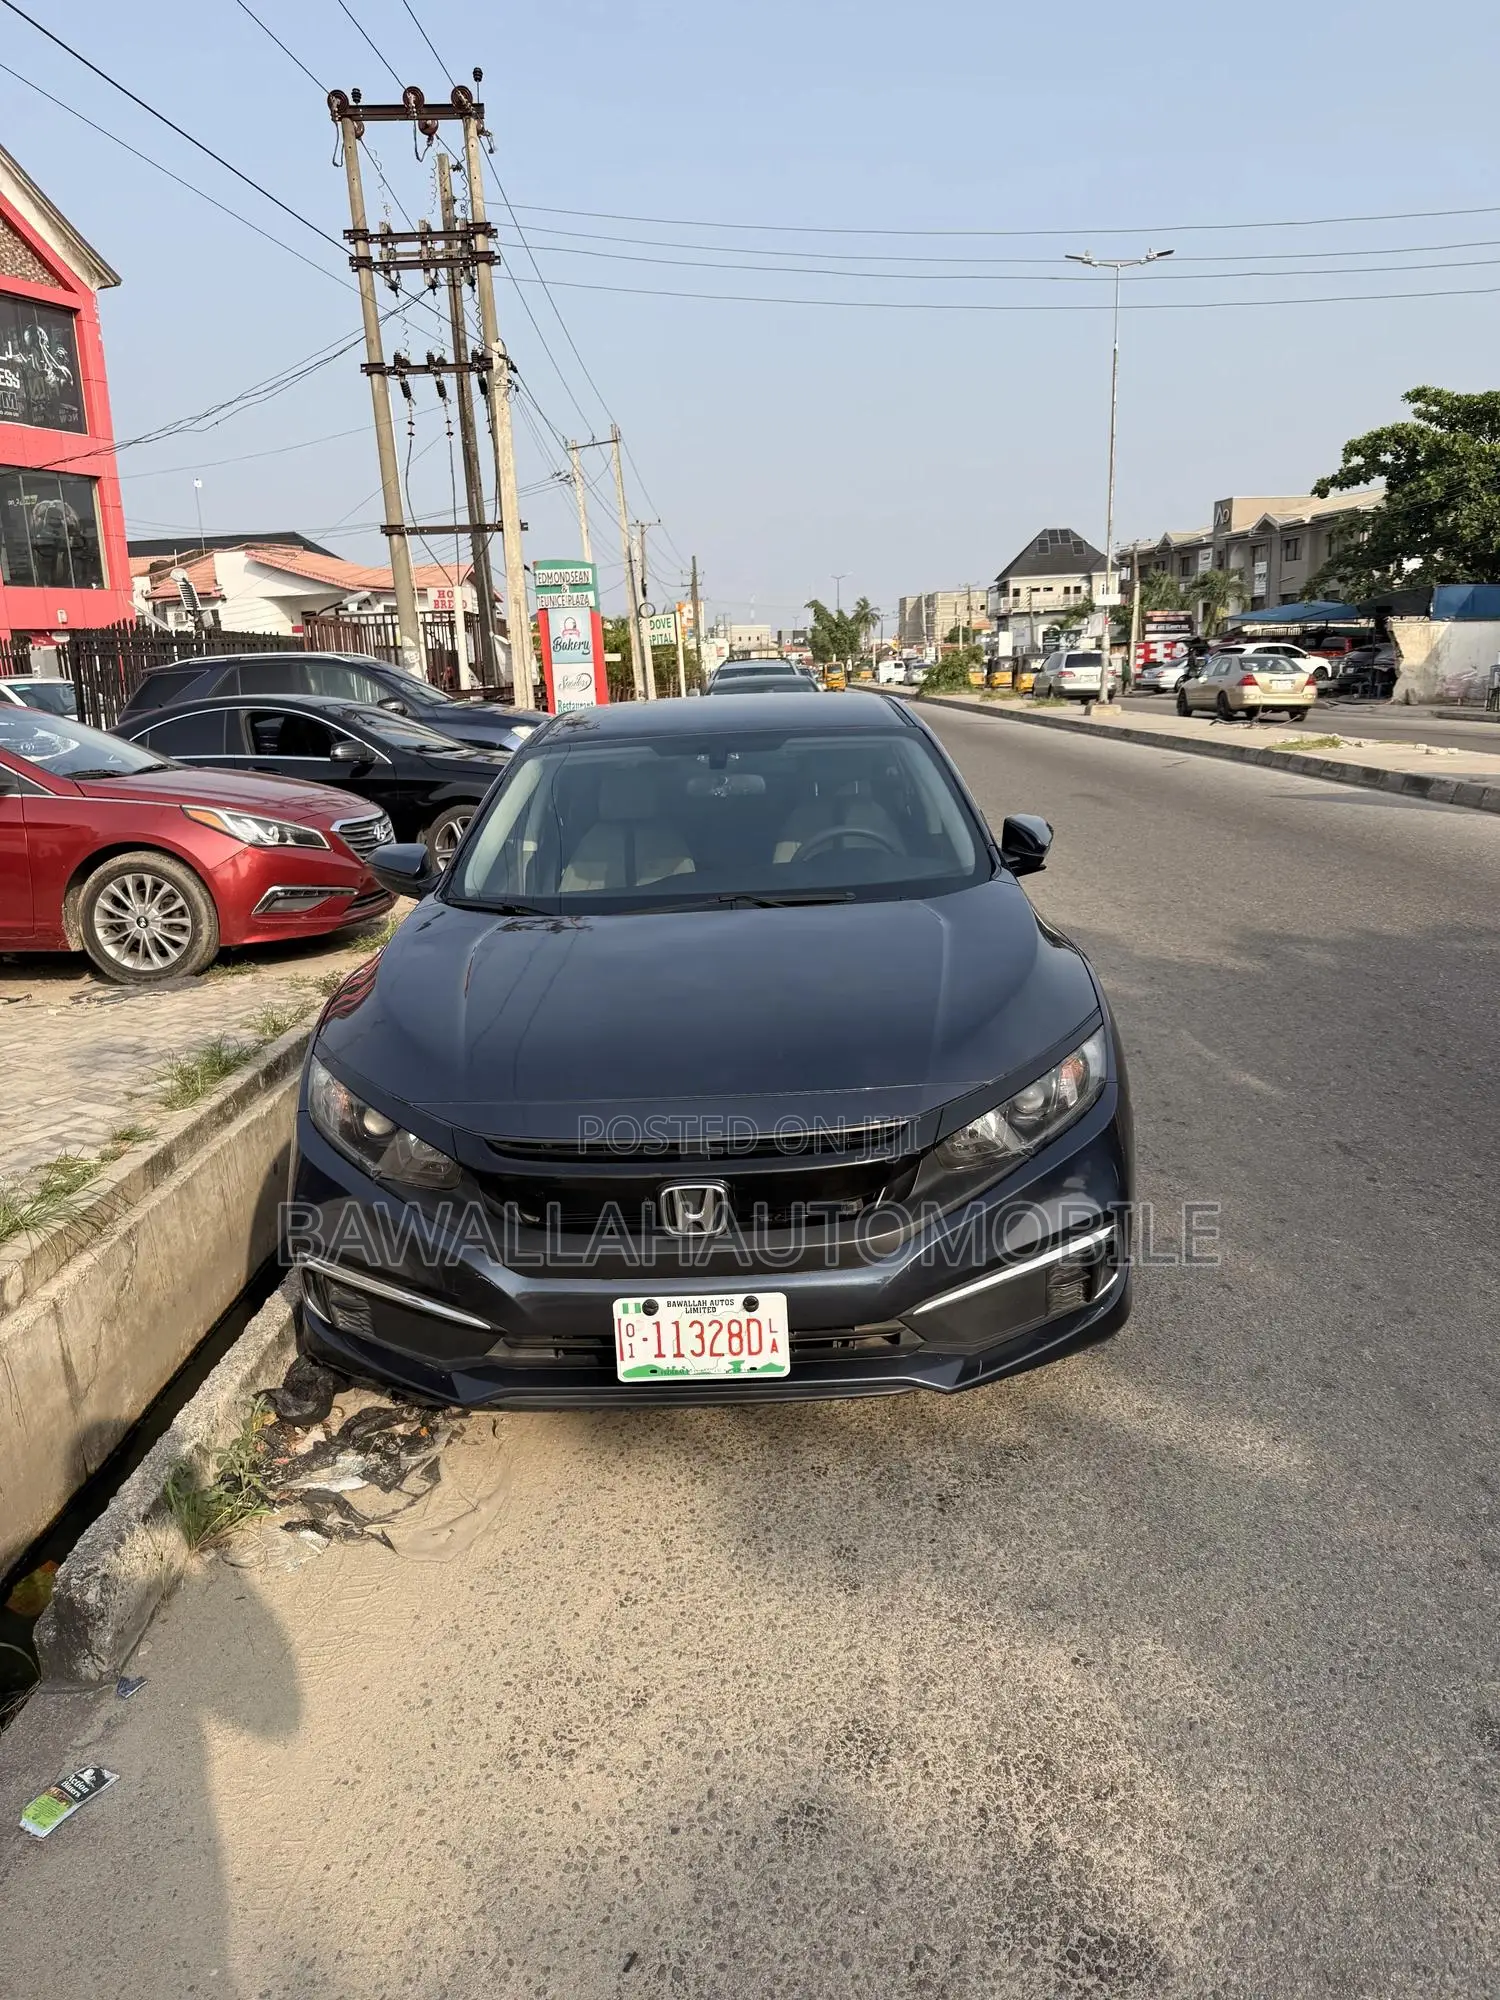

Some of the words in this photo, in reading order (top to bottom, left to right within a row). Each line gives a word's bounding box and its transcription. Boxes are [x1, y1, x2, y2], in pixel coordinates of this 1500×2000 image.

[538, 571, 590, 584] EDMONDSEAN
[437, 589, 454, 599] HO
[561, 585, 568, 593] &
[433, 599, 468, 609] BRED
[567, 594, 590, 606] PLAZA
[650, 617, 672, 630] DOVE
[553, 636, 591, 655] Bakery
[666, 1299, 708, 1308] BAWALLAH
[709, 1298, 735, 1307] AUTOS
[685, 1306, 717, 1314] LIMITED
[65, 1774, 90, 1794] Action
